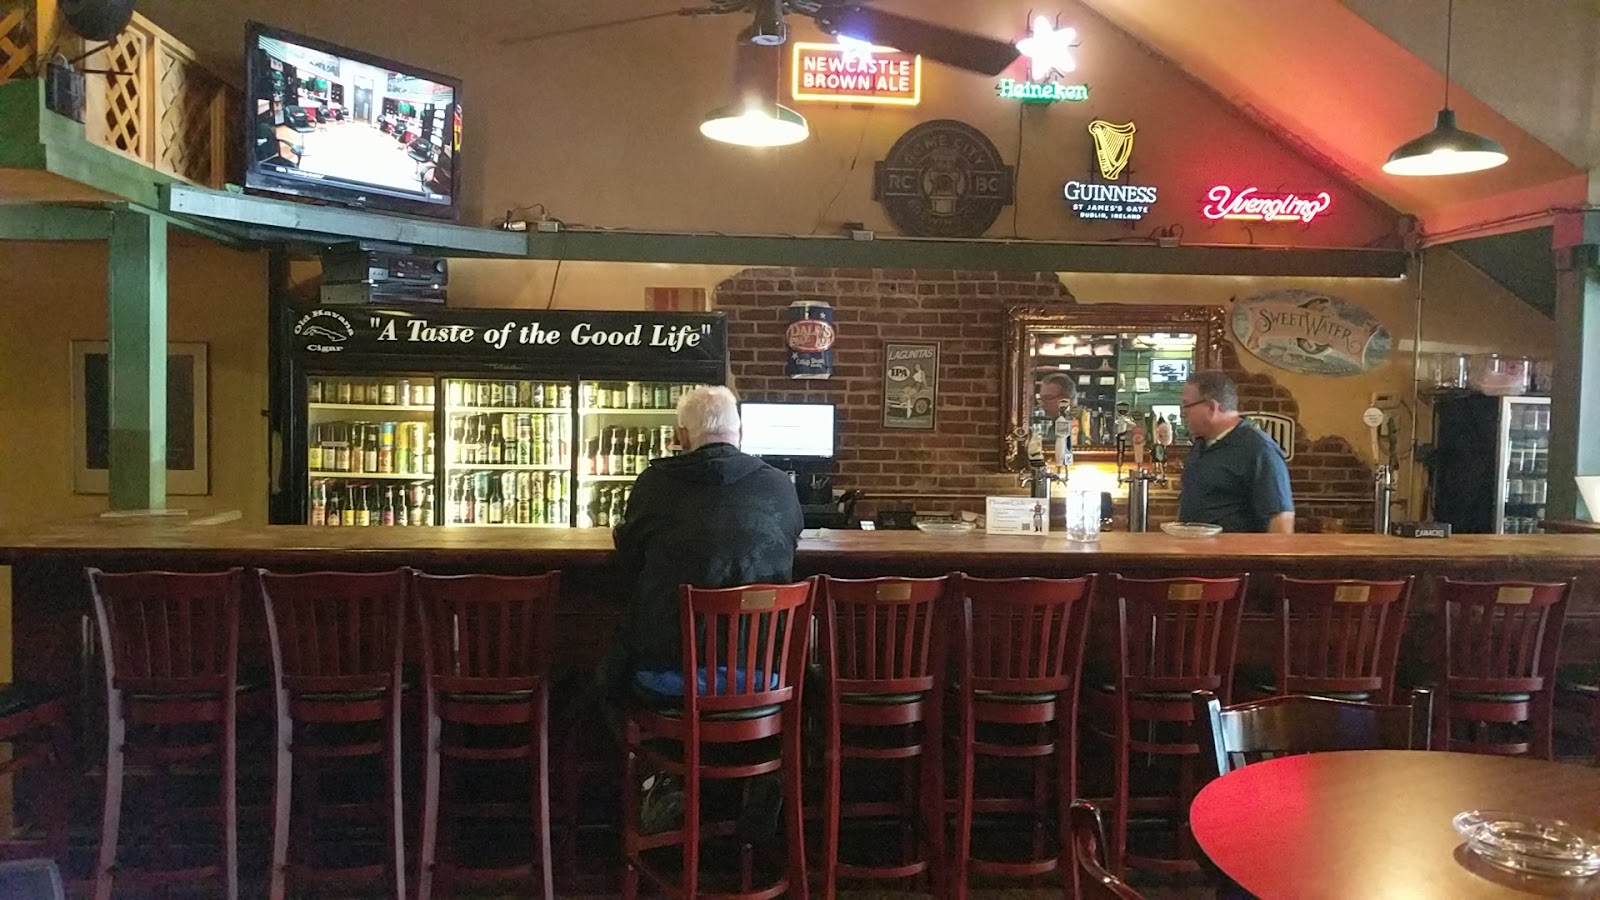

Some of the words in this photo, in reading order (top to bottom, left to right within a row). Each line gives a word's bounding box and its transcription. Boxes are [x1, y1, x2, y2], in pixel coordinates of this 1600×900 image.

[803, 56, 910, 76] NEWCASTLE
[803, 73, 870, 90] BROWN
[876, 76, 910, 92] ALE
[1000, 79, 1089, 101] Heineken
[888, 174, 916, 189] RC
[975, 176, 999, 193] BC
[1064, 181, 1157, 204] GUINNESS
[1072, 203, 1084, 211] ST
[1087, 204, 1123, 212] JAMES'S
[1126, 205, 1149, 214] GATE
[1203, 185, 1331, 223] Yuengling
[1080, 212, 1108, 220] DUBLIN,
[293, 314, 312, 336] Old
[311, 308, 355, 337] Havana
[790, 324, 832, 338] DALE'S
[370, 317, 399, 342] "A
[407, 319, 475, 343] Taste
[483, 321, 516, 350] of
[519, 322, 561, 345] the
[570, 322, 643, 346] Good
[649, 323, 712, 353] Life"
[306, 344, 344, 353] Cigar
[888, 348, 933, 361] LAGUNITAS
[890, 368, 908, 378] IPA
[1414, 529, 1445, 538] CAMACHO
